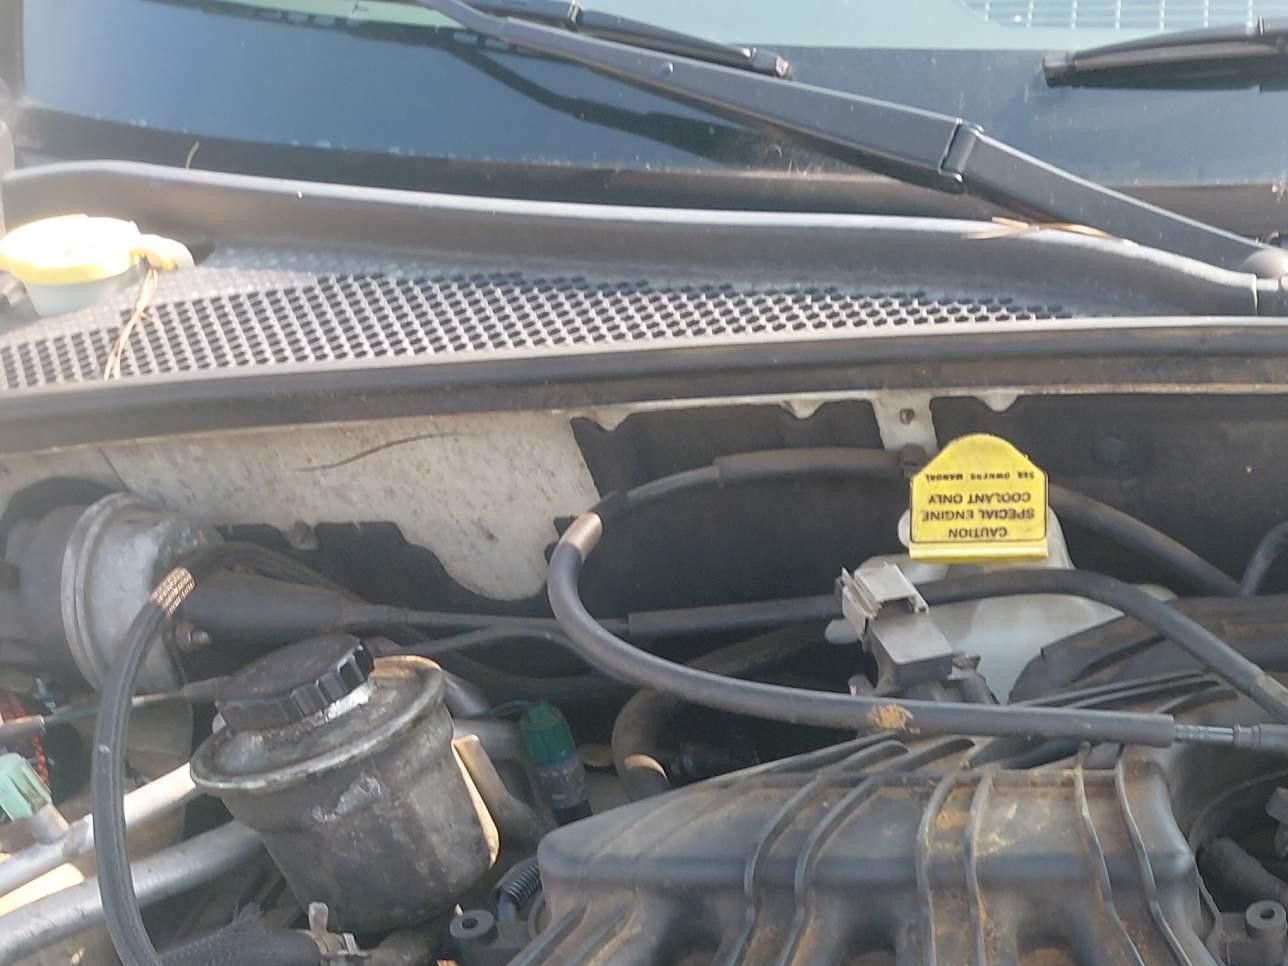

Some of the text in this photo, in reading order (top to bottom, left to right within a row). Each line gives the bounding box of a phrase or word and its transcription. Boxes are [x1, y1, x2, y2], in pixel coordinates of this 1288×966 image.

[925, 473, 964, 484] MANUAL
[928, 492, 1031, 505] COOLANT ONLY
[922, 508, 1036, 522] SPECIAL ENGINE
[948, 526, 1008, 539] CAUTION
